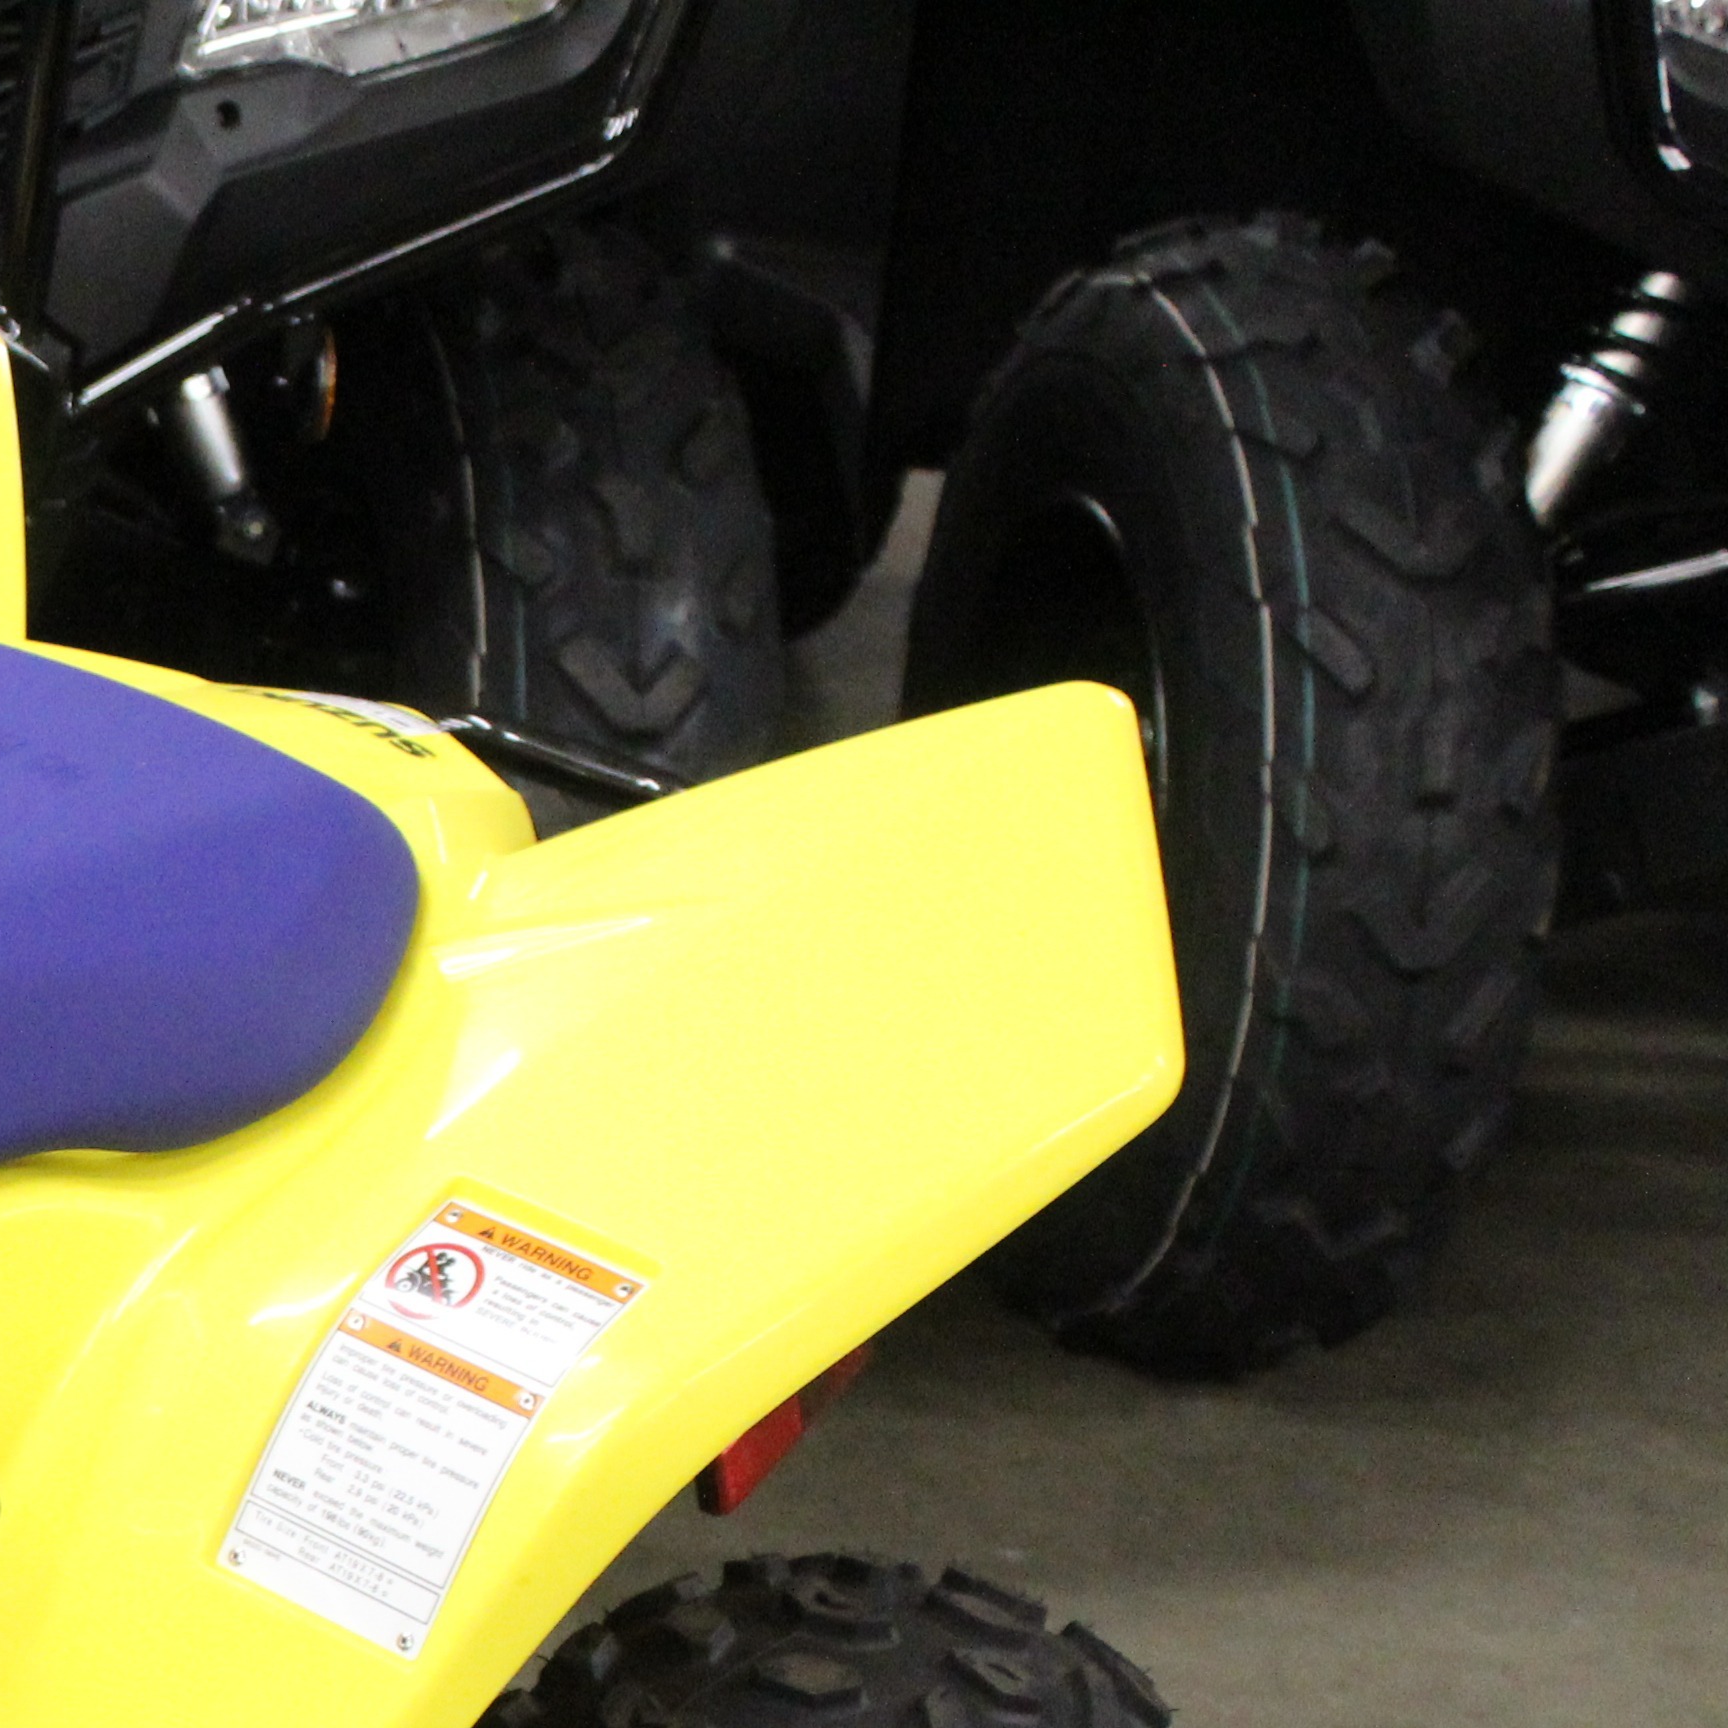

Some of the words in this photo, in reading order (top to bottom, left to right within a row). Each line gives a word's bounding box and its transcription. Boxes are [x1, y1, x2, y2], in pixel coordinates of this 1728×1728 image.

[497, 1232, 596, 1282] WARNING
[405, 1343, 491, 1393] WARNING
[305, 1400, 348, 1425] ALWAYS
[272, 1467, 307, 1491] NEVER
